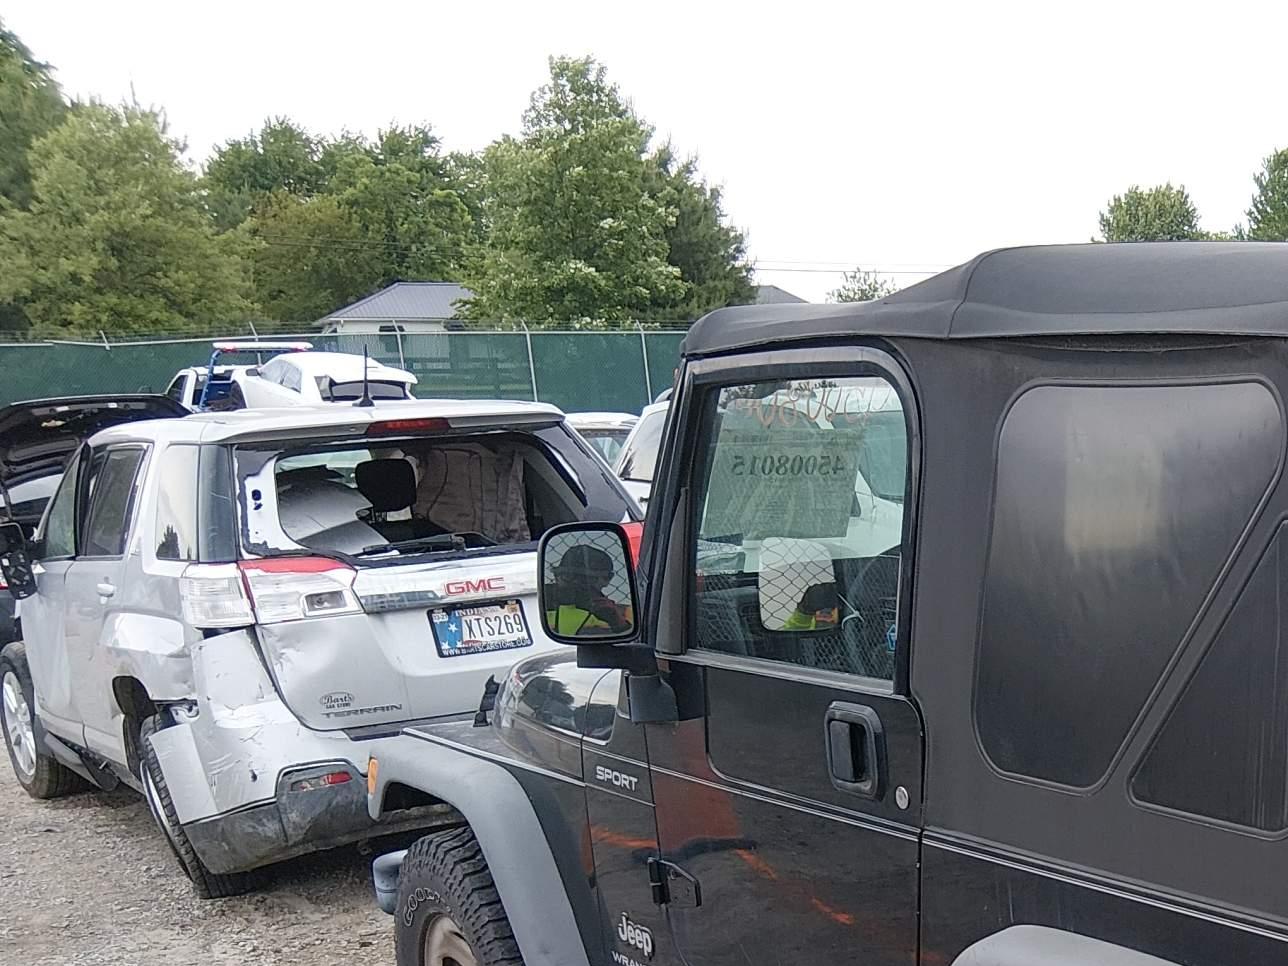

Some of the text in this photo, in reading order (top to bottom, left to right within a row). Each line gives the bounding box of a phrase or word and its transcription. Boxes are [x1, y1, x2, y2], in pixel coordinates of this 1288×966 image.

[445, 577, 505, 596] GMC
[464, 613, 524, 640] XTS269
[321, 703, 403, 719] TERRAIN
[595, 766, 639, 792] SPORT
[618, 911, 654, 958] Jeep
